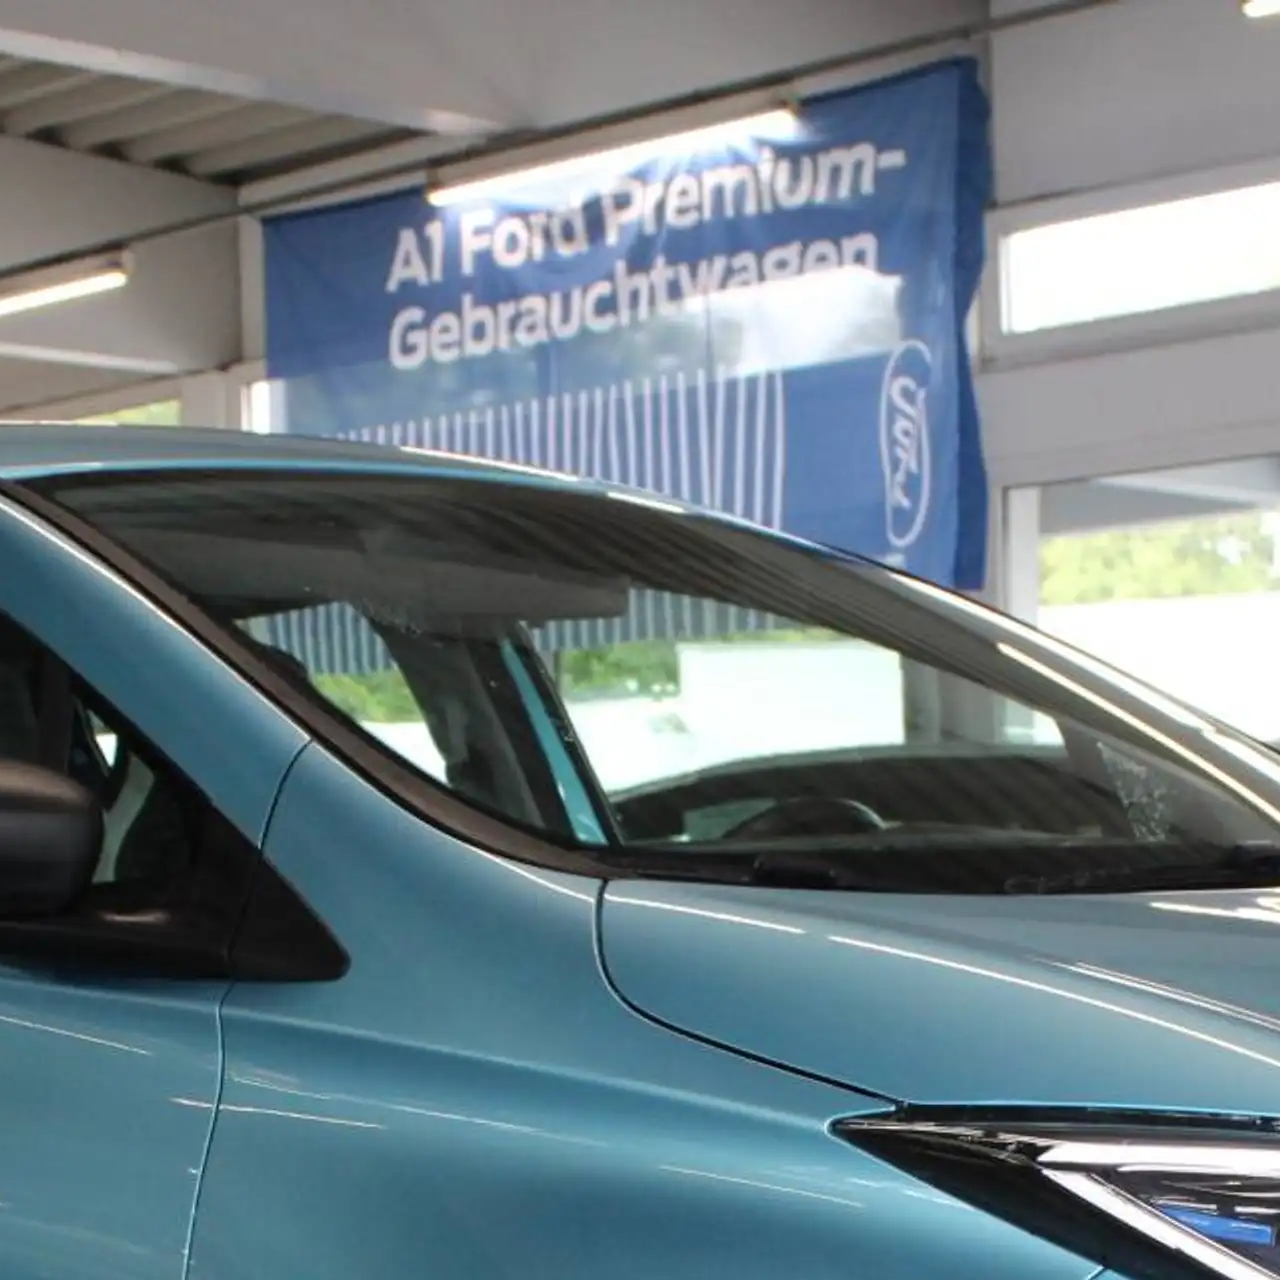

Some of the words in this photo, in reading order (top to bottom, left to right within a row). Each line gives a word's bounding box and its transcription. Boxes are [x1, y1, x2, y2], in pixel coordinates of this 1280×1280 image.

[385, 220, 444, 293] A1
[460, 197, 589, 277] Ford
[602, 143, 908, 247] Premium-
[389, 232, 878, 370] Gebrauchtwagen
